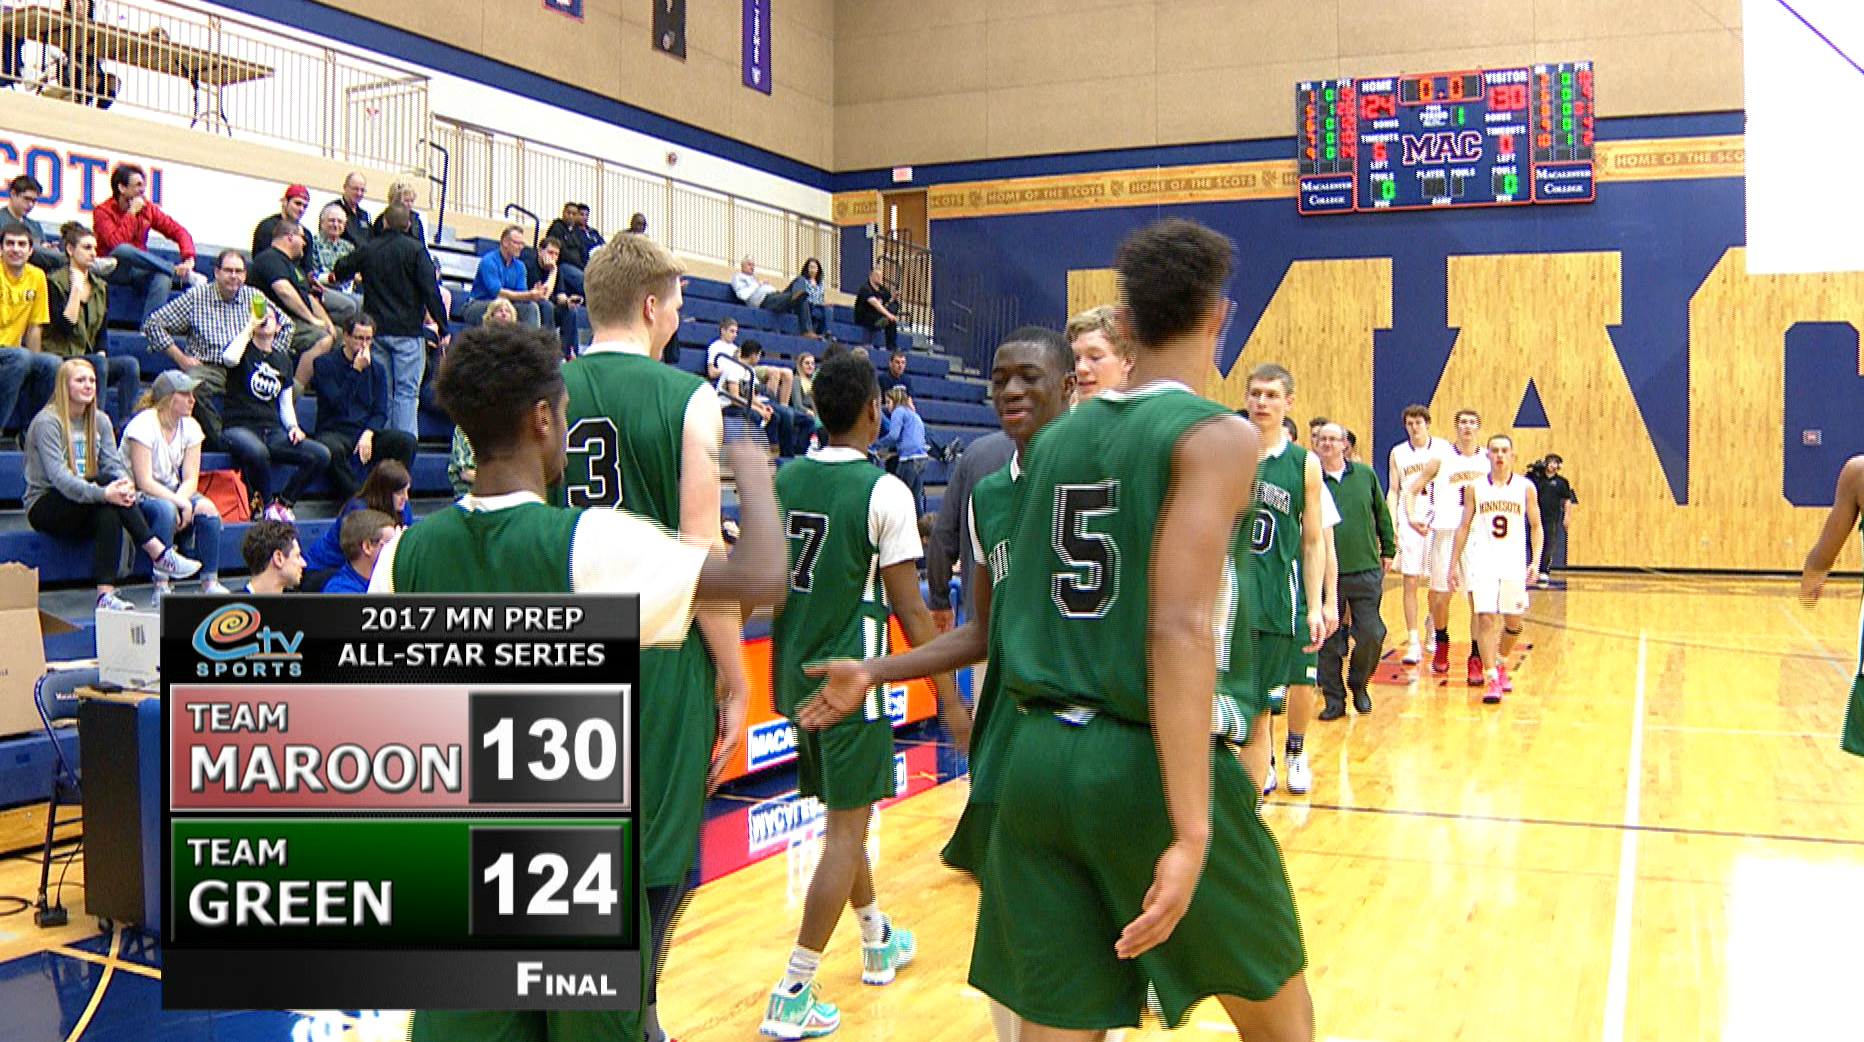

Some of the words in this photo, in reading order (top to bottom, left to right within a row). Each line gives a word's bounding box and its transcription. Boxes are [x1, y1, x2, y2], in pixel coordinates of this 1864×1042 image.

[1361, 80, 1393, 92] HOME
[1484, 70, 1528, 84] VISITOR
[1360, 93, 1396, 118] 124
[1488, 84, 1527, 110] 130
[1402, 130, 1483, 166] MAC
[1614, 154, 1658, 168] HOME
[1662, 153, 1681, 166] OF
[1687, 152, 1712, 164] THE
[986, 190, 1021, 207] HOME
[1025, 188, 1040, 203] OF
[1043, 187, 1065, 202] THE
[1067, 183, 1105, 200] SCOTS
[1129, 179, 1160, 194] HOME
[1171, 178, 1186, 191] OF
[1190, 176, 1212, 189] THE
[1215, 173, 1256, 188] SCOTS
[1382, 180, 1397, 201] 0
[1503, 174, 1518, 195] 0
[565, 416, 624, 510] 3
[1479, 501, 1521, 515] MINNESOTA
[1491, 515, 1508, 538] 9
[786, 510, 830, 594] 7
[1051, 479, 1122, 620] 5
